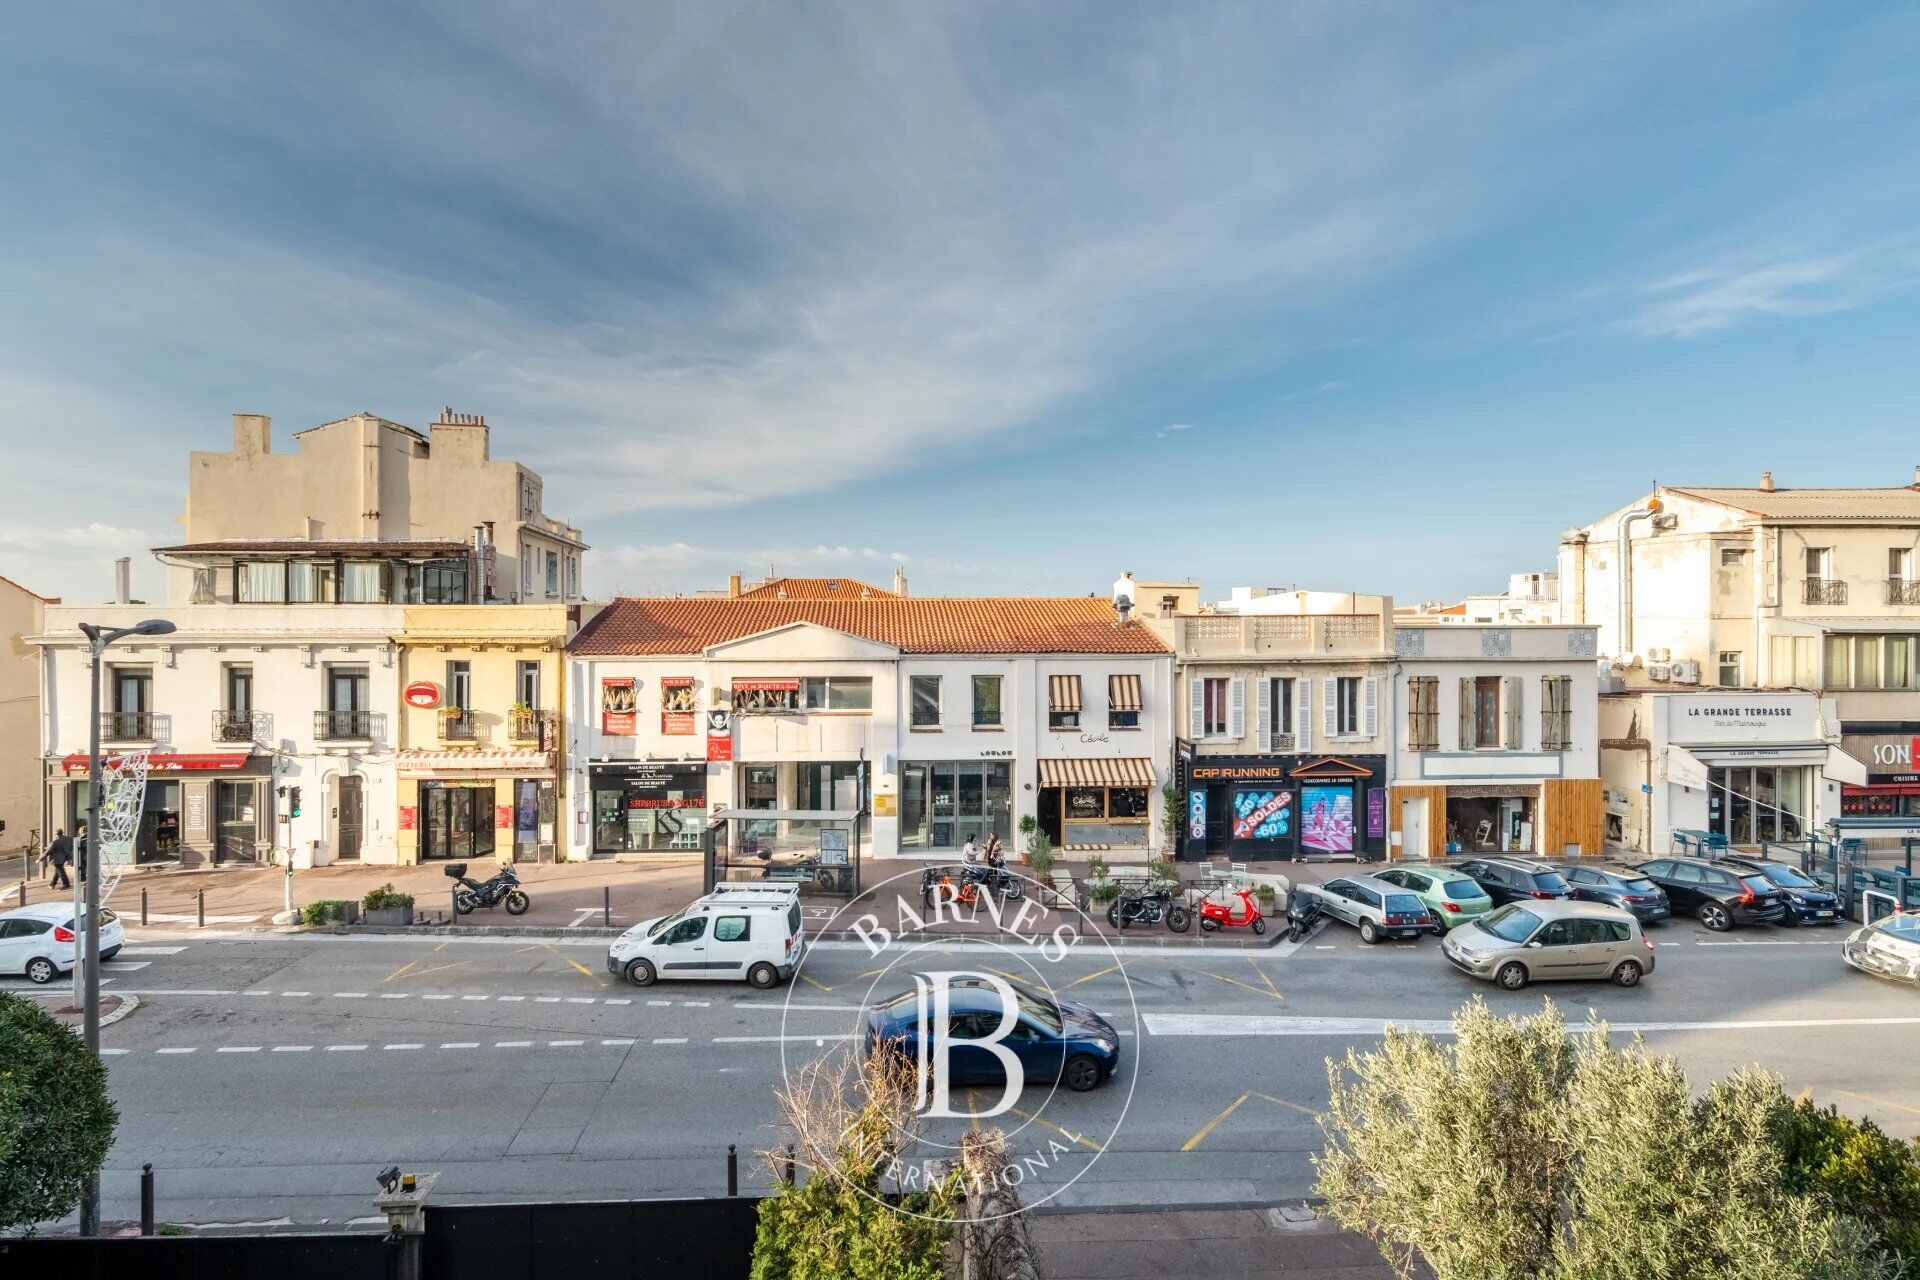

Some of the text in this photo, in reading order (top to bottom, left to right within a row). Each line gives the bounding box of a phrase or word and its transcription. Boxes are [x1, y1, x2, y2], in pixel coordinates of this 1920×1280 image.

[1688, 708, 1792, 716] LA GRANDE TERRASSE
[1873, 744, 1912, 765] SON
[1193, 768, 1280, 778] CAP RUNNING
[1247, 791, 1291, 826] SOLDES
[655, 808, 683, 834] KS
[1254, 820, 1288, 838] -60%
